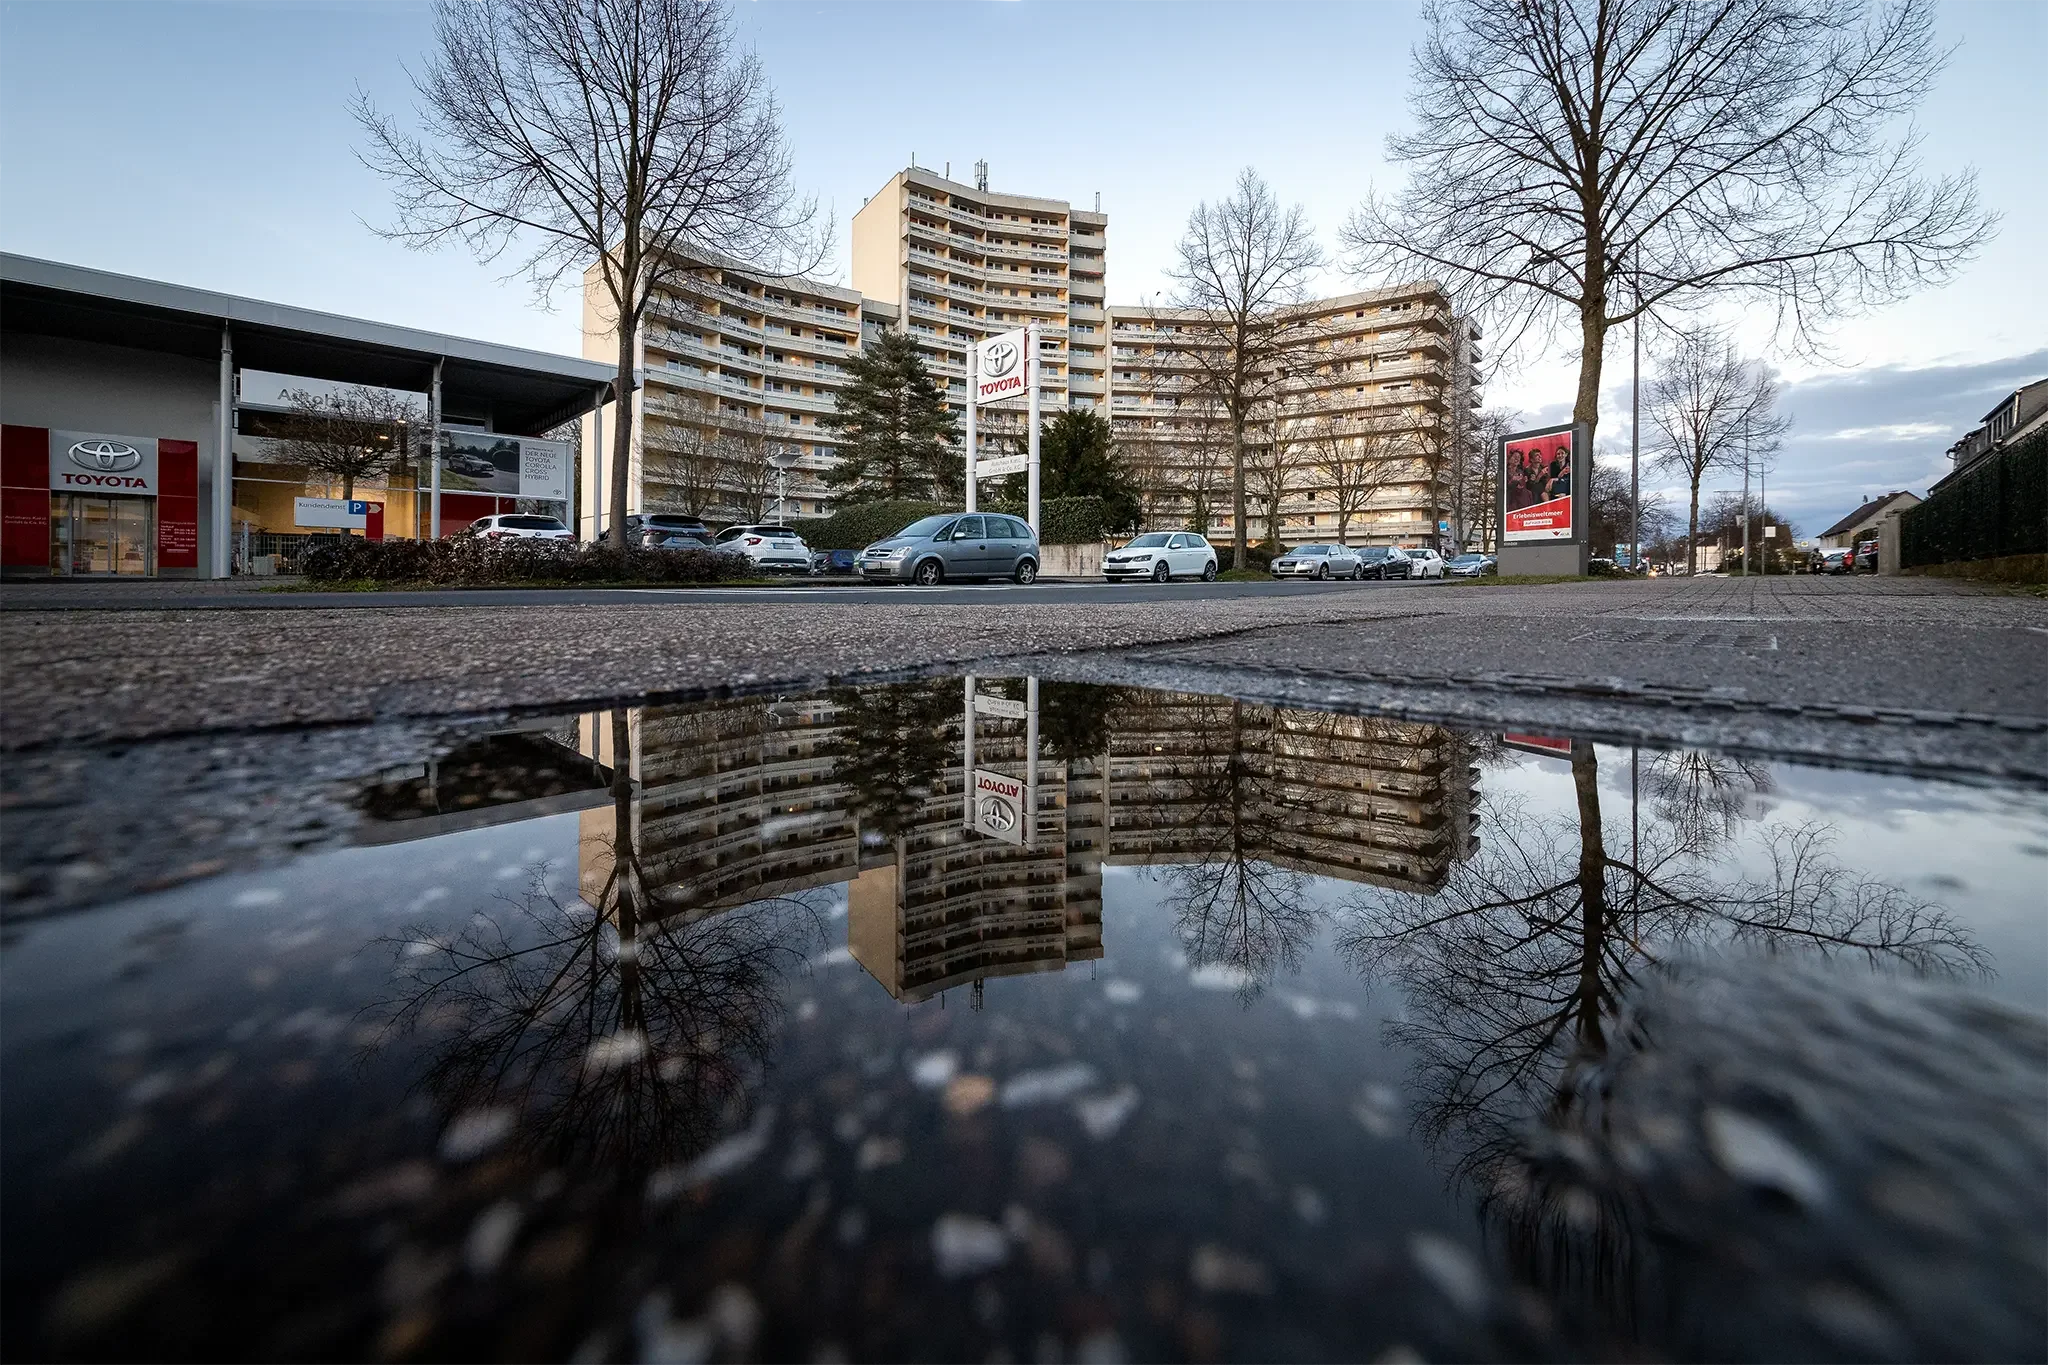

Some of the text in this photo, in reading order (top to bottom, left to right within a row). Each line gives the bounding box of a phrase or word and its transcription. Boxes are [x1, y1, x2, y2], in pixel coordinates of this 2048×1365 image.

[979, 376, 1022, 396] TOYOTA
[525, 456, 551, 464] TOYOTA
[525, 462, 557, 470] COROLLA
[61, 473, 148, 489] TOYOTA
[298, 502, 362, 513] Kundendienst P
[1513, 511, 1563, 519] Erlebnisweltmeer
